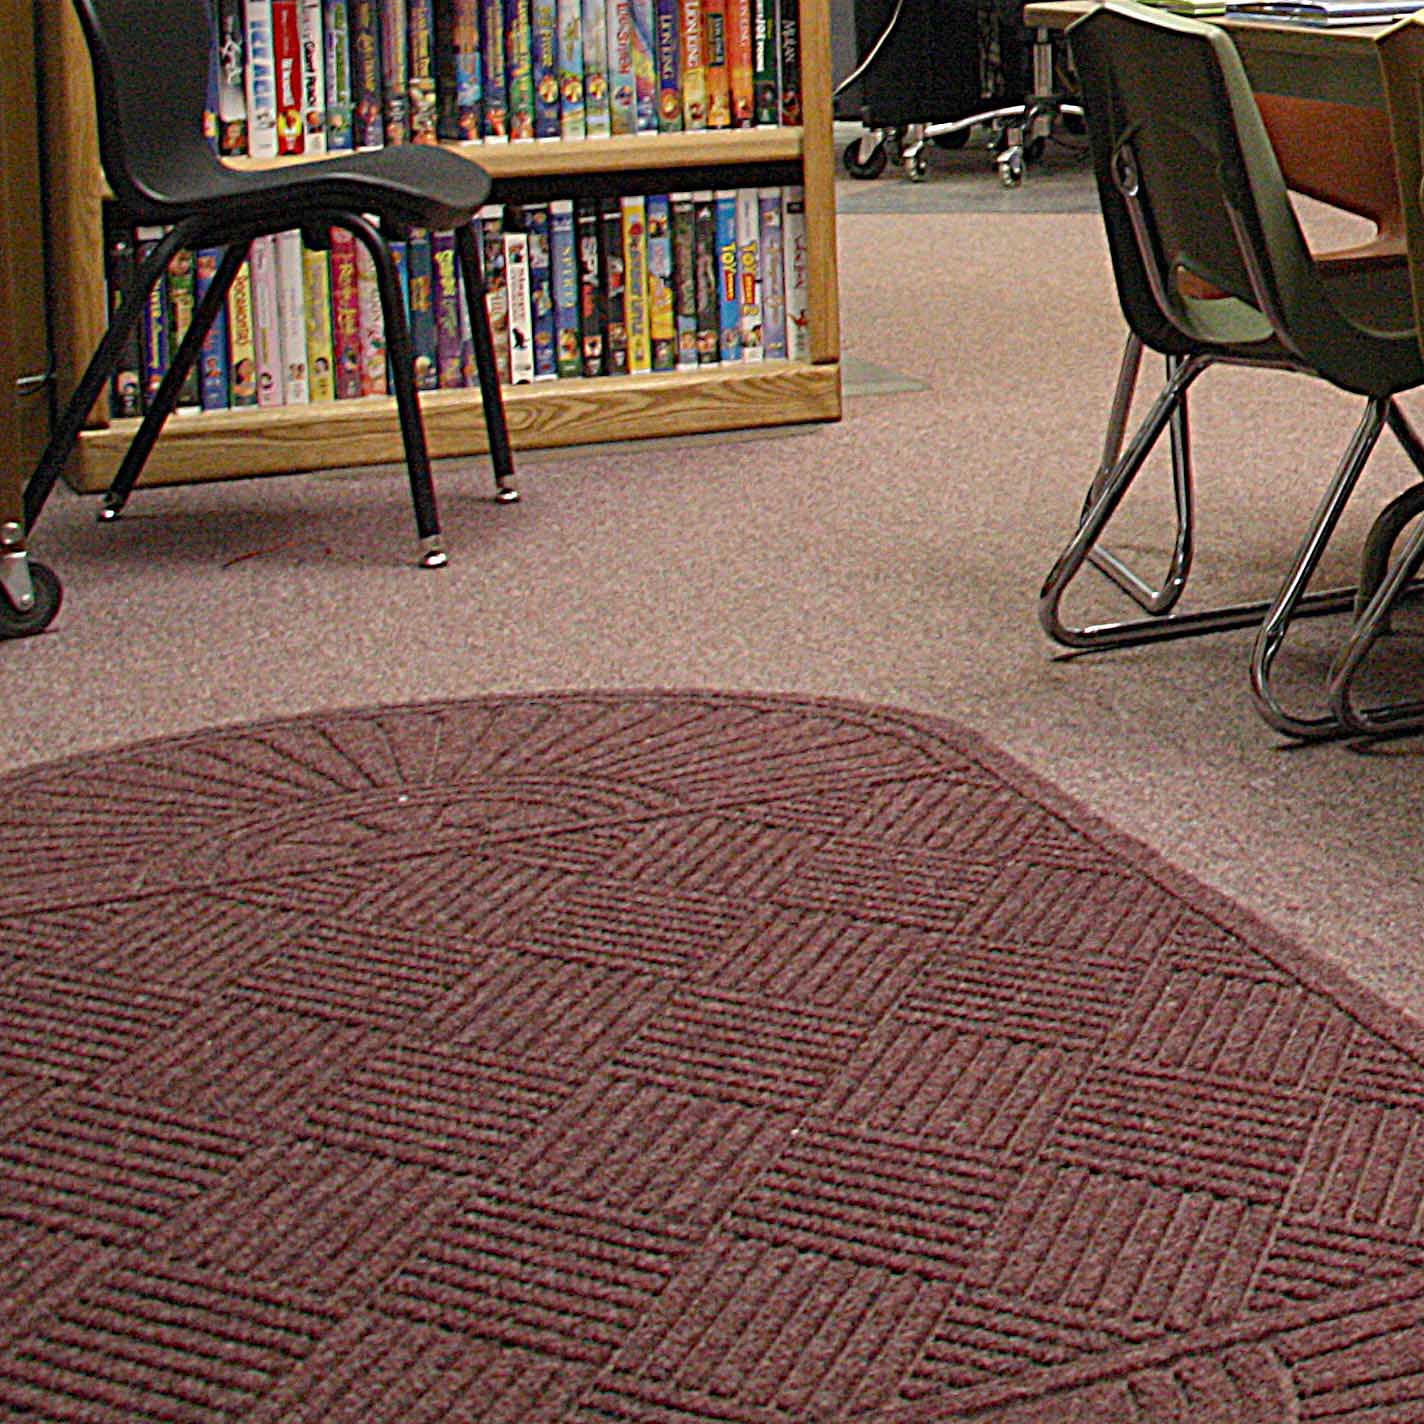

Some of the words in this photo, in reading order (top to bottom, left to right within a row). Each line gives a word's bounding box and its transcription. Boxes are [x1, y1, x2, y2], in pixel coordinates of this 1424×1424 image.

[581, 236, 598, 285] SPY
[721, 243, 736, 272] TOY
[740, 243, 758, 273] TOY
